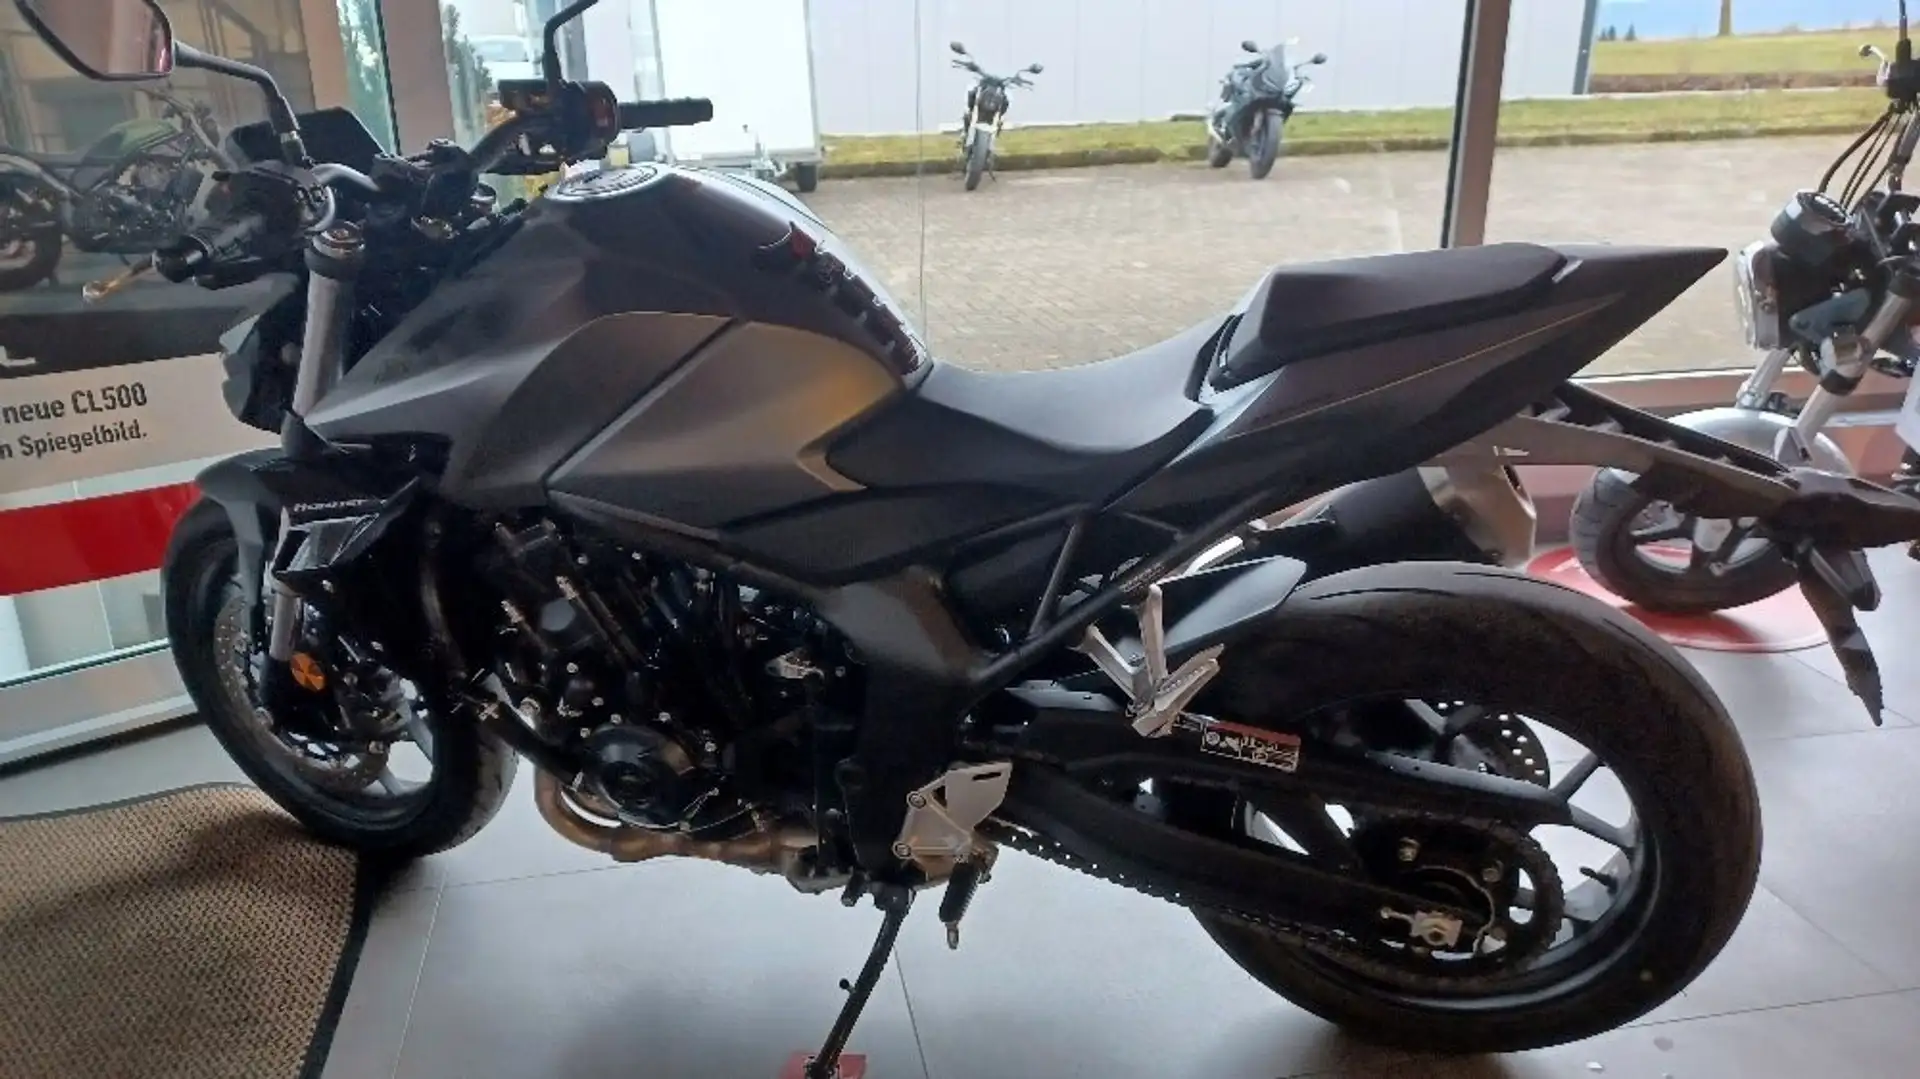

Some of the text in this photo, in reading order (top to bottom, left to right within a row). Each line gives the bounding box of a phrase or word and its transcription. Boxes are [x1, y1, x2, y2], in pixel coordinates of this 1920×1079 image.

[3, 382, 147, 424] neue CL500
[18, 419, 147, 459] Spiegelbild.
